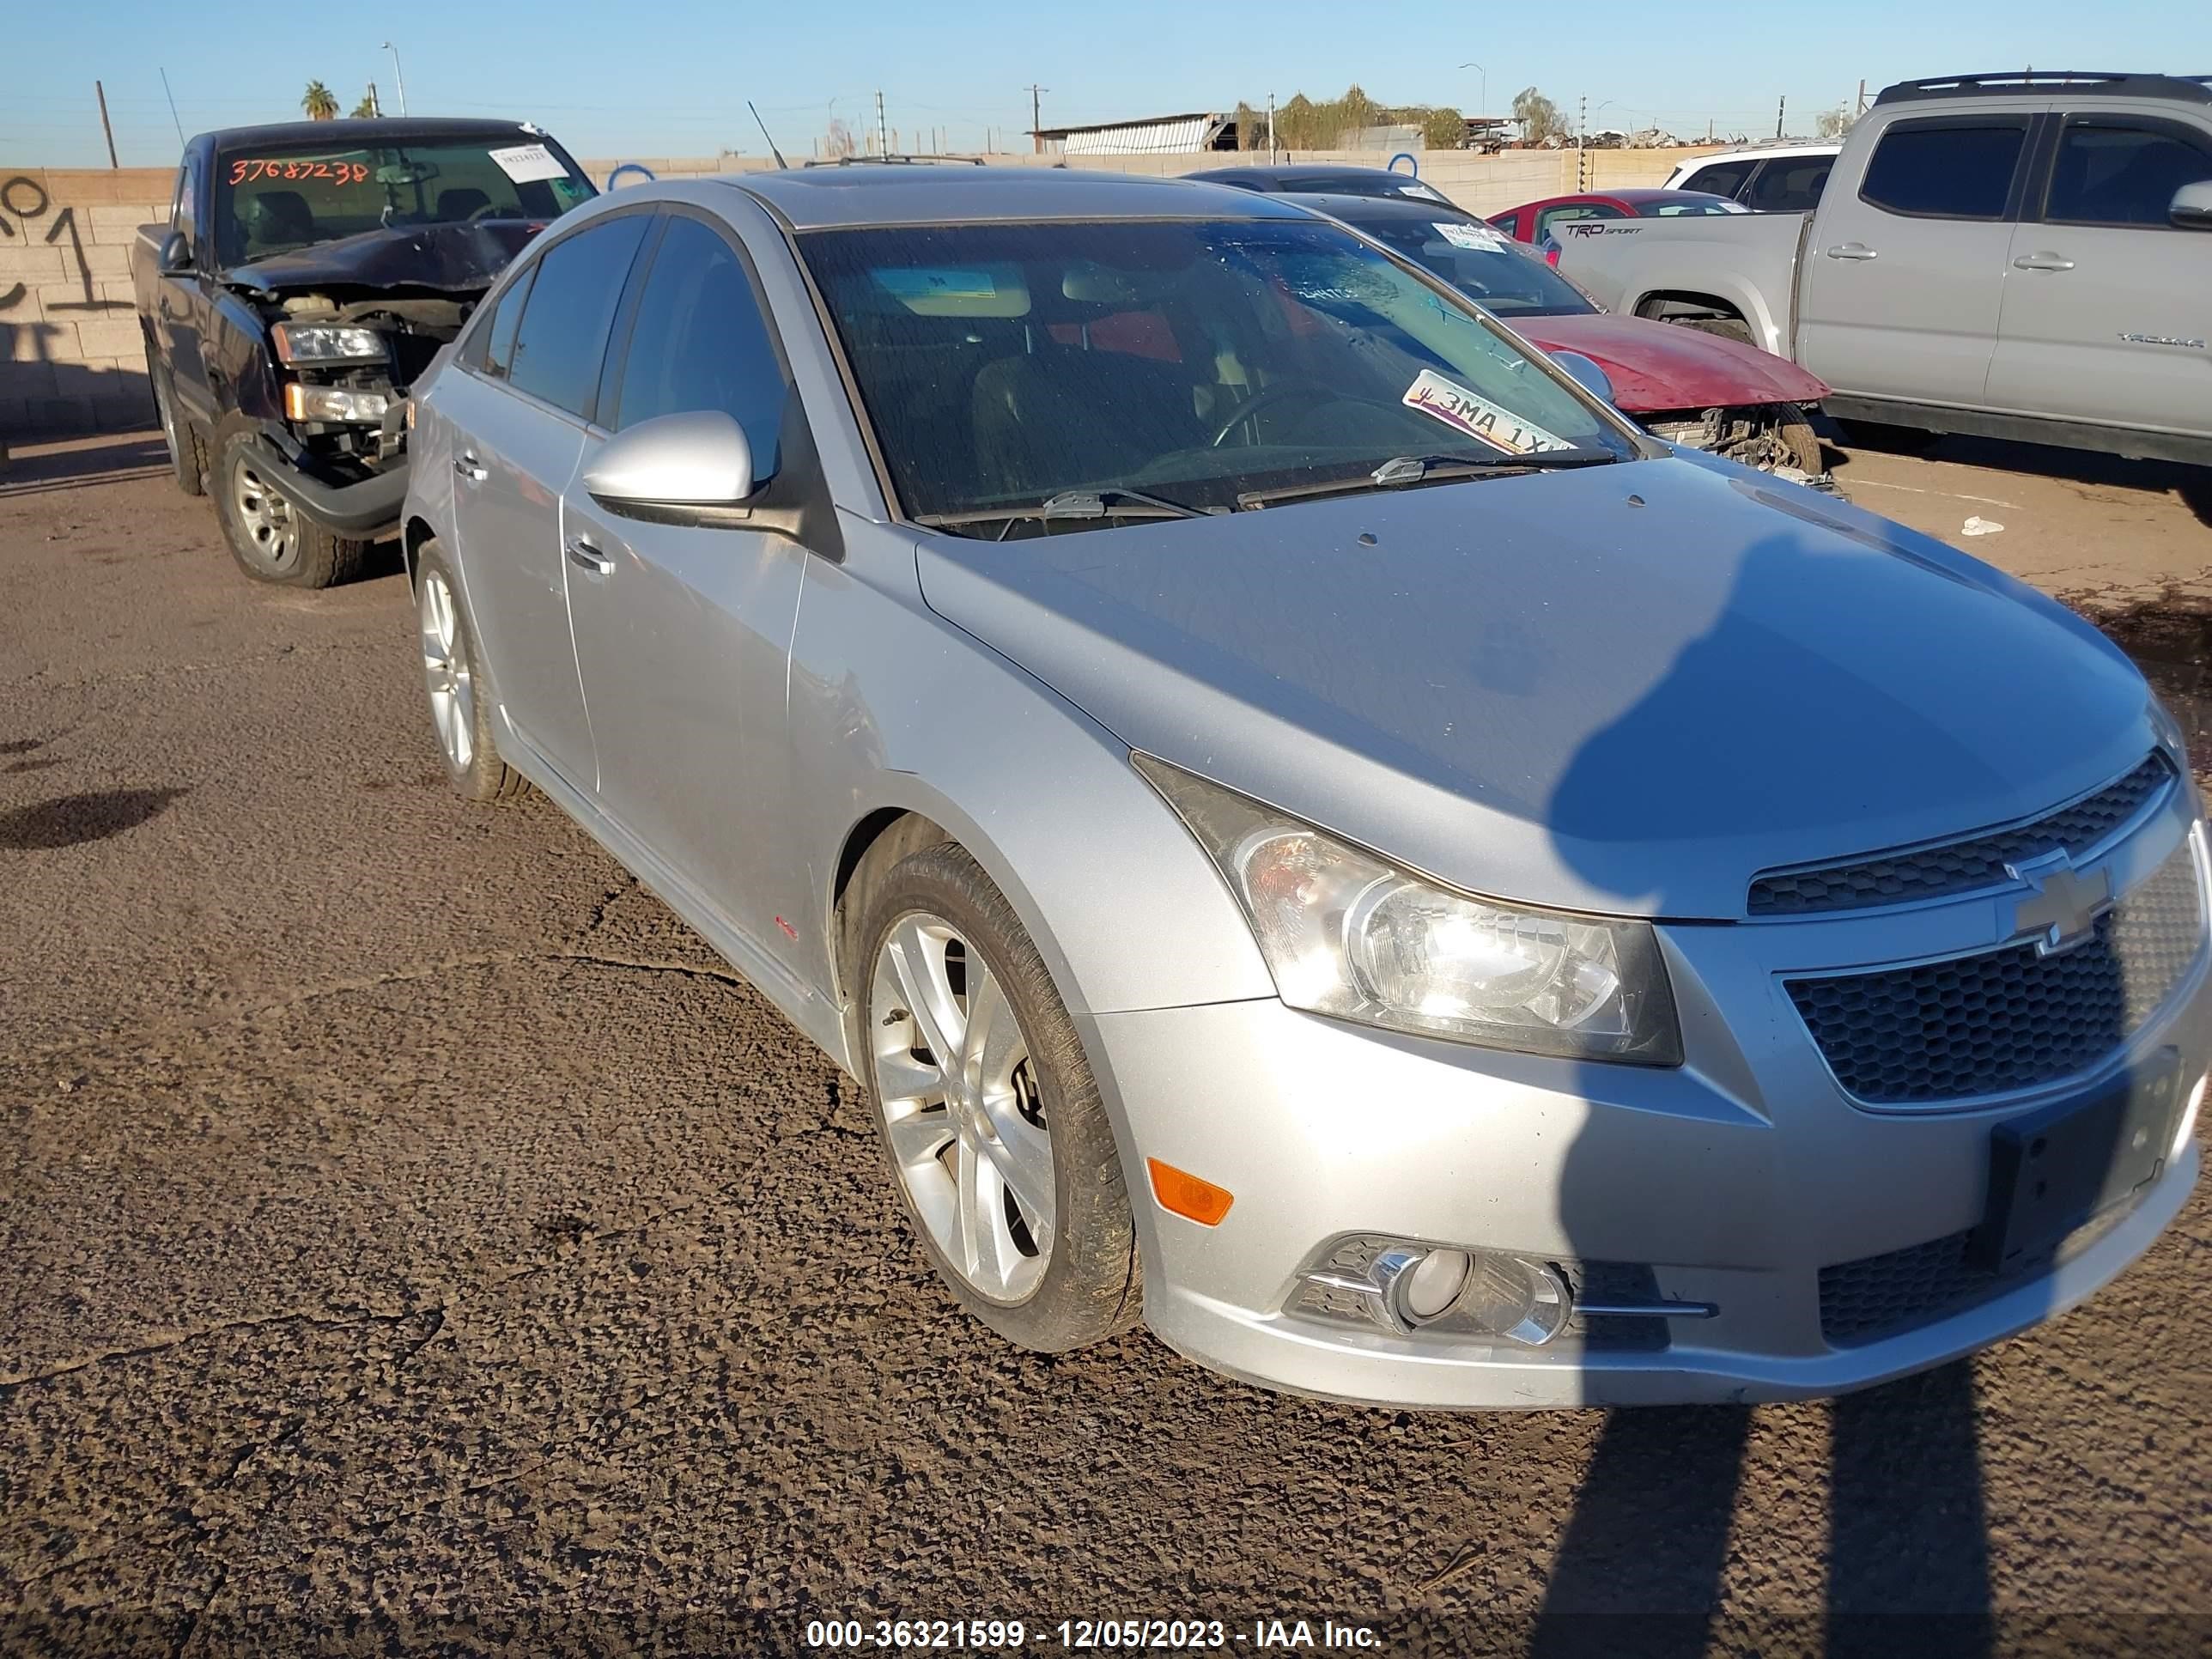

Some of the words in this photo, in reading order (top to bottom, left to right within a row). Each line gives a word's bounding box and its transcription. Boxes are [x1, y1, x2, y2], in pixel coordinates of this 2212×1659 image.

[228, 160, 369, 185] 37687238
[1566, 224, 1605, 239] TRD
[1440, 392, 1497, 433] 3MA
[1504, 428, 1554, 453] 1X
